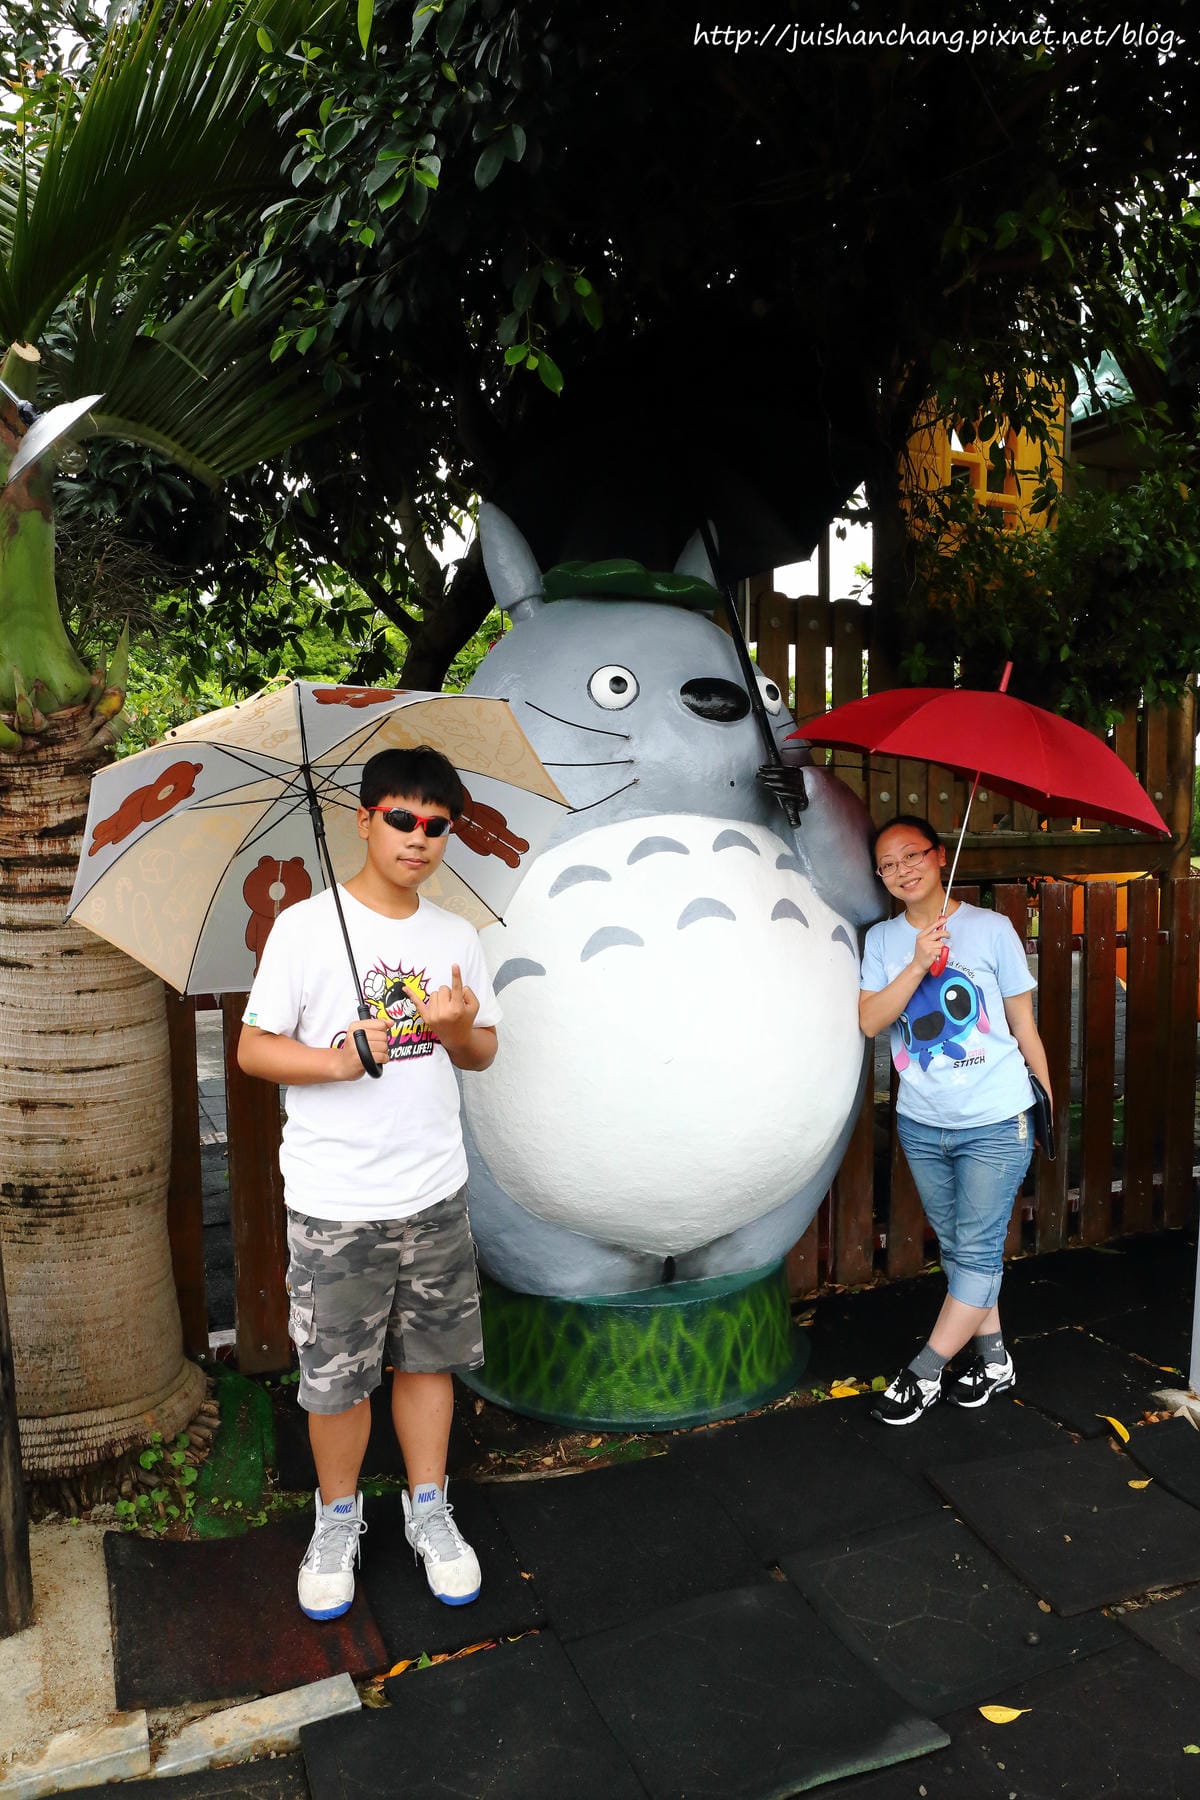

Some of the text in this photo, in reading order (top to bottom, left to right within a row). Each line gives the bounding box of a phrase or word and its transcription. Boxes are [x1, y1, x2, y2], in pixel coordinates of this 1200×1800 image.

[390, 1042, 433, 1059] YOUR LIFE!!
[953, 1055, 986, 1069] STITCH
[418, 1489, 437, 1504] NIKE
[333, 1501, 354, 1514] NIKE
